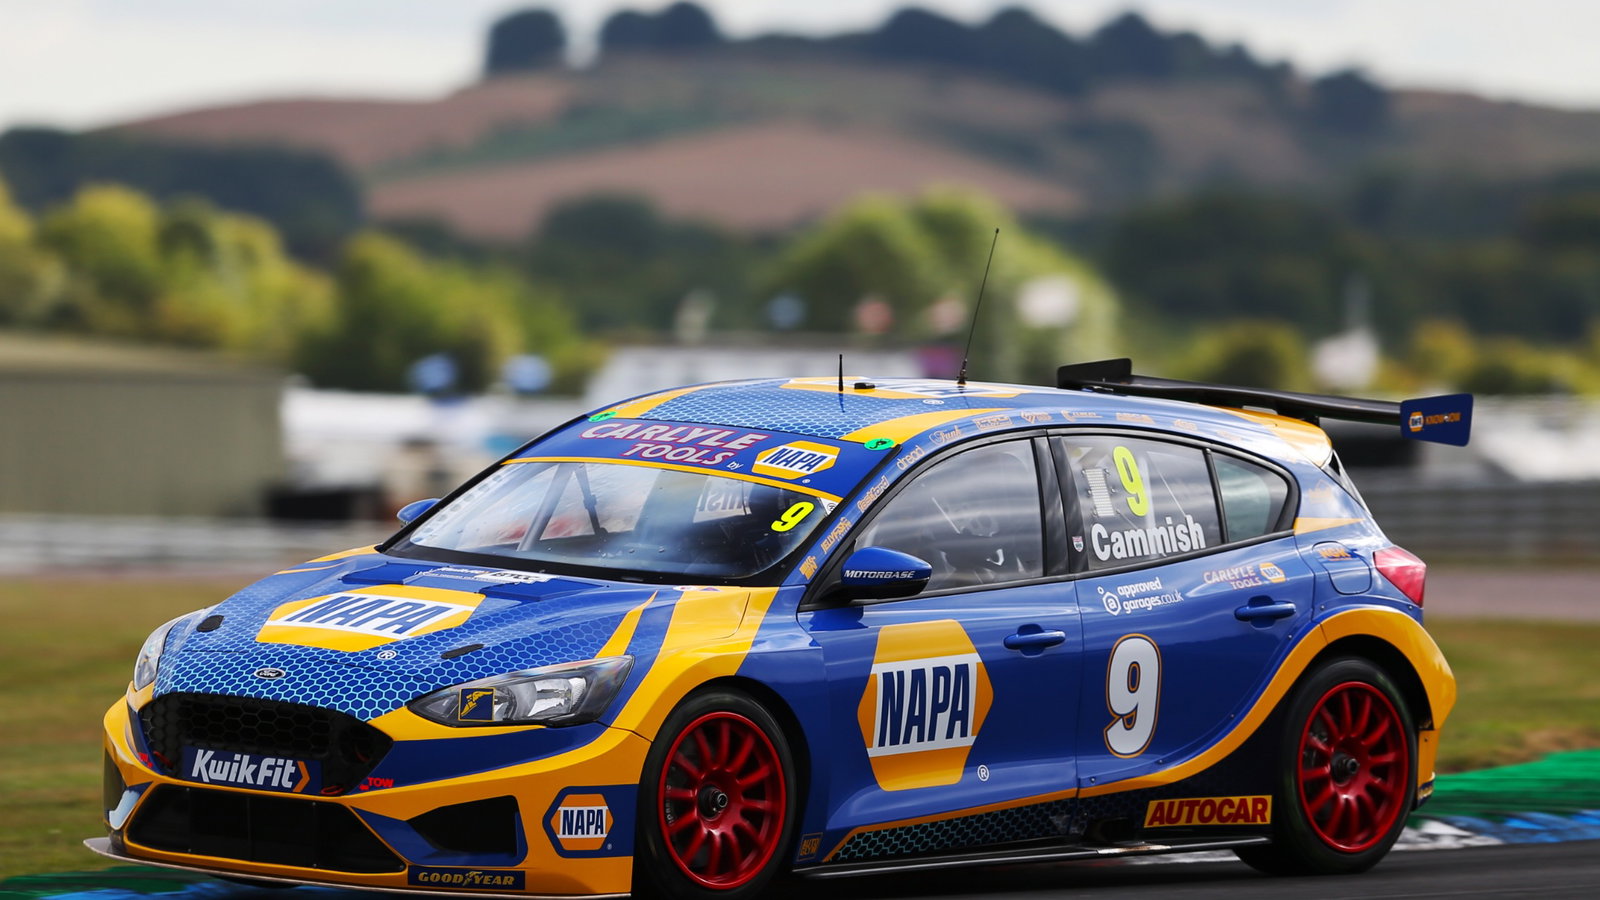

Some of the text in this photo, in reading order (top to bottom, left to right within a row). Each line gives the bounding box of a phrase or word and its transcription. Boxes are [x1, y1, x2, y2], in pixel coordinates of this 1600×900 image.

[581, 422, 770, 450] CARLYLE
[623, 442, 744, 471] TOOLS by
[763, 448, 828, 472] NAPA
[1113, 446, 1150, 517] 9
[771, 501, 815, 532] 9
[1090, 514, 1206, 561] Cammish
[844, 570, 916, 579] MOTORBASE
[1117, 576, 1163, 597] approved
[1202, 565, 1256, 585] CARLYLE
[1230, 576, 1264, 591] TOOLS
[284, 595, 453, 634] NAPA
[1122, 589, 1185, 615] garages.co.uk
[878, 663, 970, 747] NAPA
[1103, 632, 1163, 760] 9
[367, 777, 394, 788] TOW
[561, 808, 605, 836] NAPA
[1147, 796, 1268, 827] AUTOCAR
